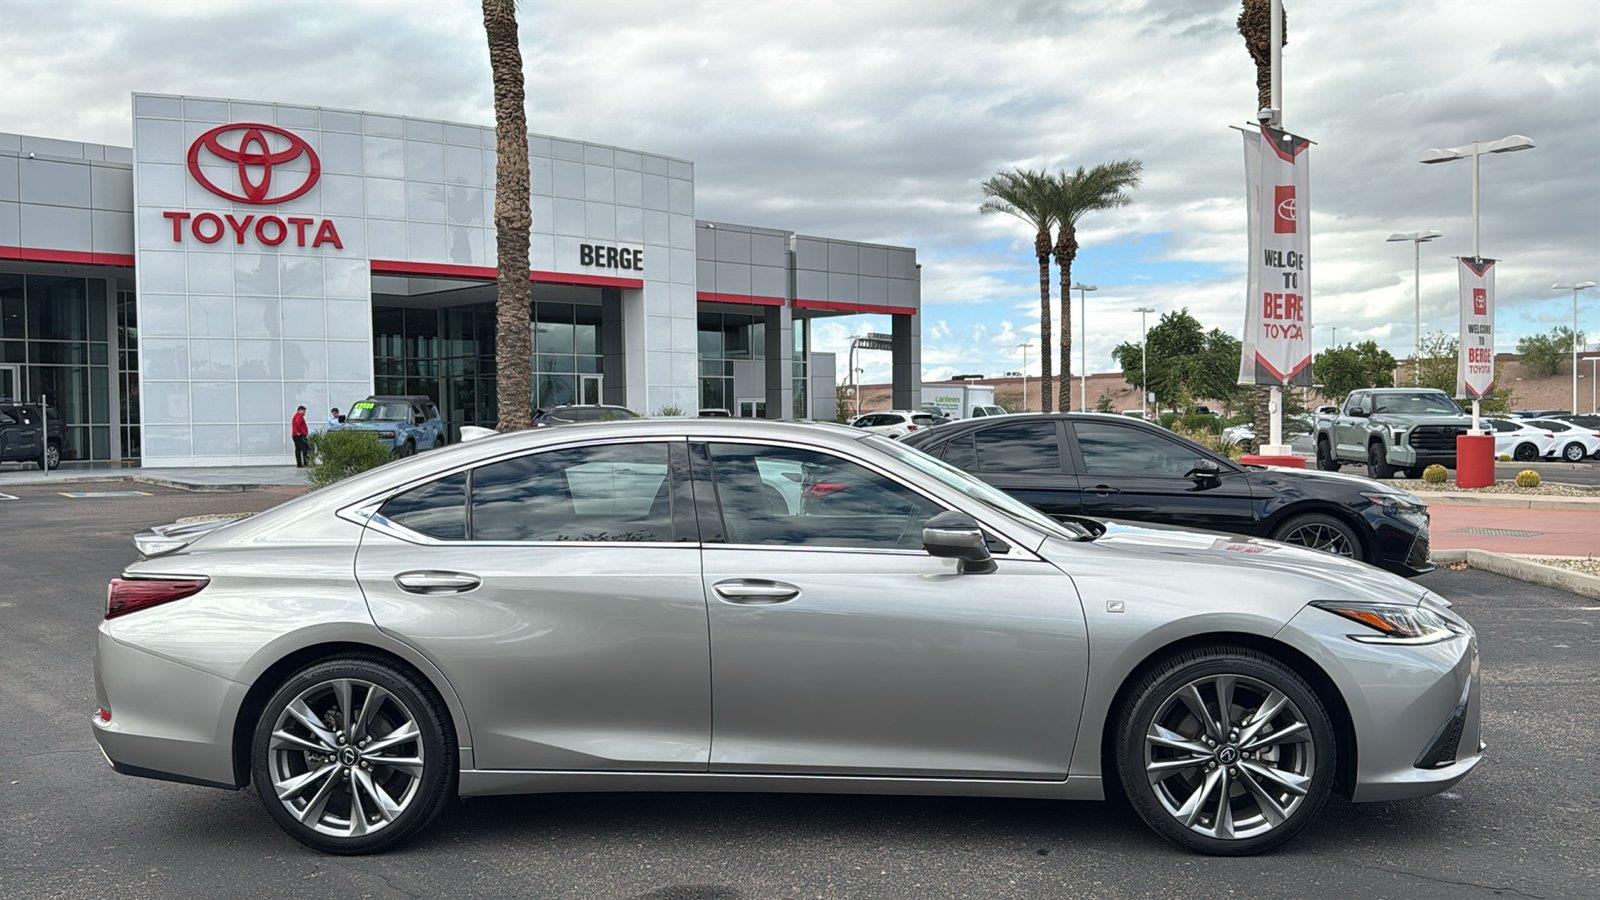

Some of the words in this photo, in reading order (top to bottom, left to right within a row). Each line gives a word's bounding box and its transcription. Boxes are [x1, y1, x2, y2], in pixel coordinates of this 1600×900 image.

[163, 211, 344, 249] TOYOTA
[580, 244, 643, 271] BERGE
[1264, 249, 1304, 270] WELCE
[1263, 292, 1304, 321] BERE
[1263, 323, 1304, 341] TOYOA
[1468, 324, 1491, 334] WELCOME
[1468, 348, 1491, 363] BERGE
[1469, 365, 1491, 374] TOYOTA
